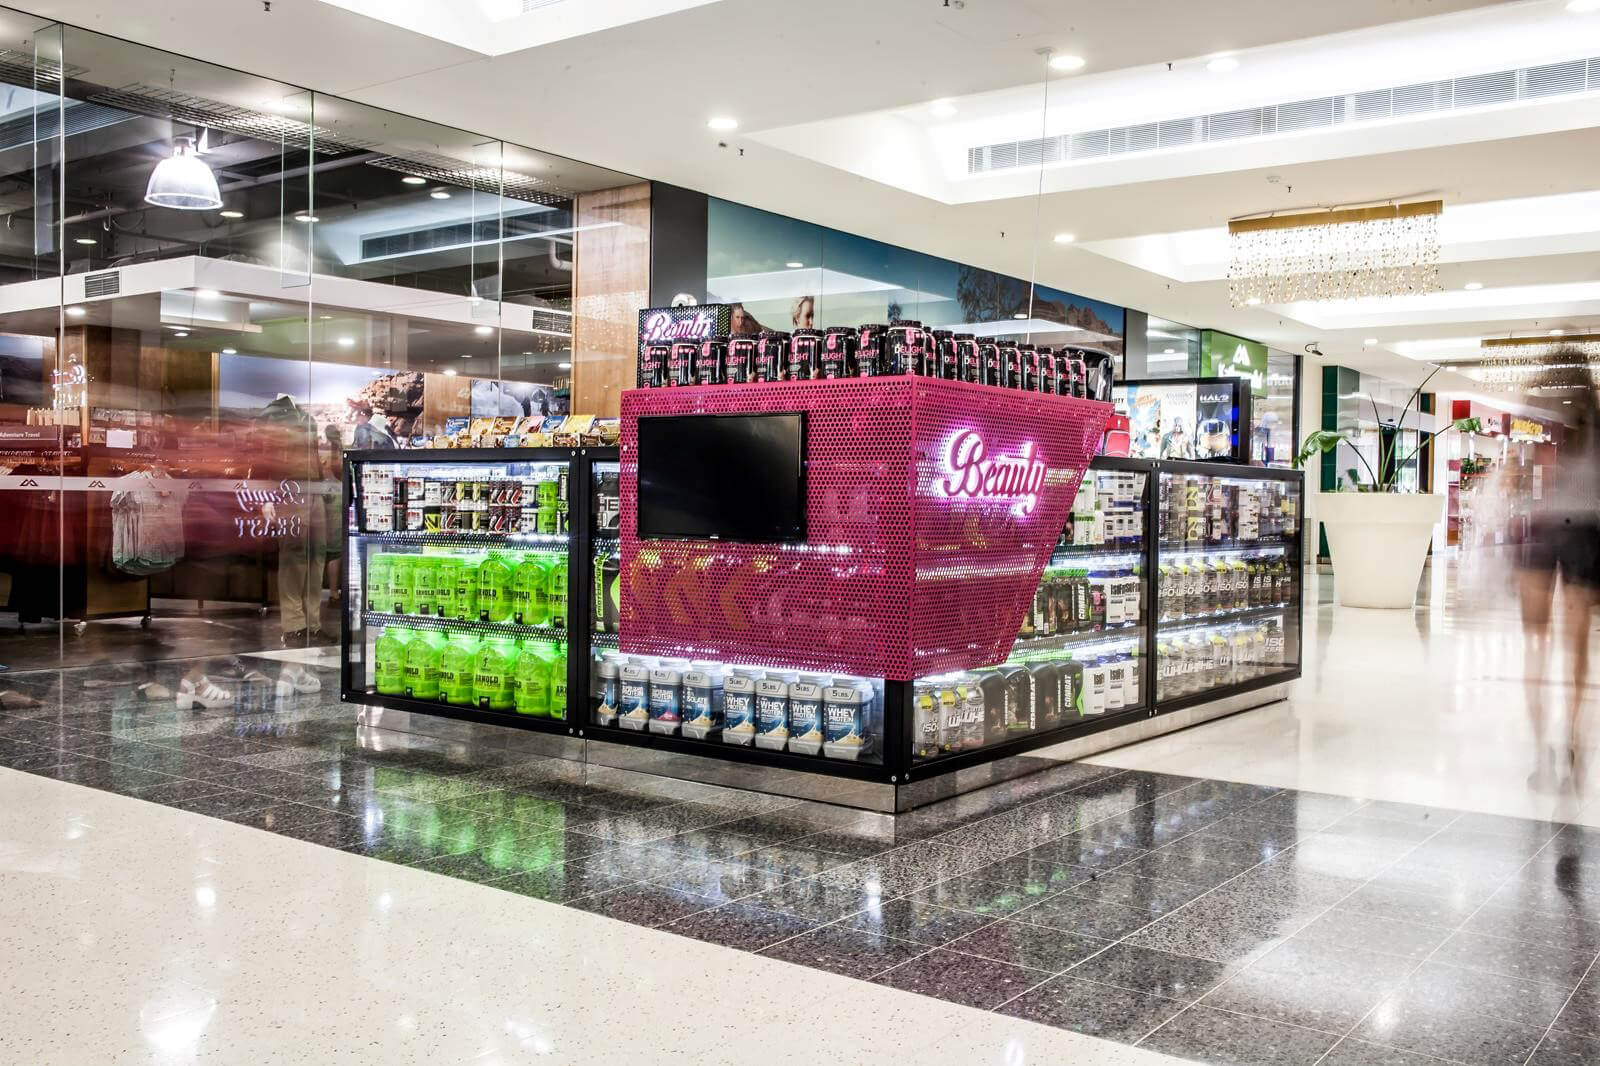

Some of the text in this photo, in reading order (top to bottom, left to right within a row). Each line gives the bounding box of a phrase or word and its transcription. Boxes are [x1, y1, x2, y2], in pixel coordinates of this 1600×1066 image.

[943, 430, 1048, 516] Beauty
[726, 696, 750, 706] WHEY
[760, 700, 786, 711] WHEY
[792, 703, 818, 714] WHEY
[828, 707, 856, 718] WHEY
